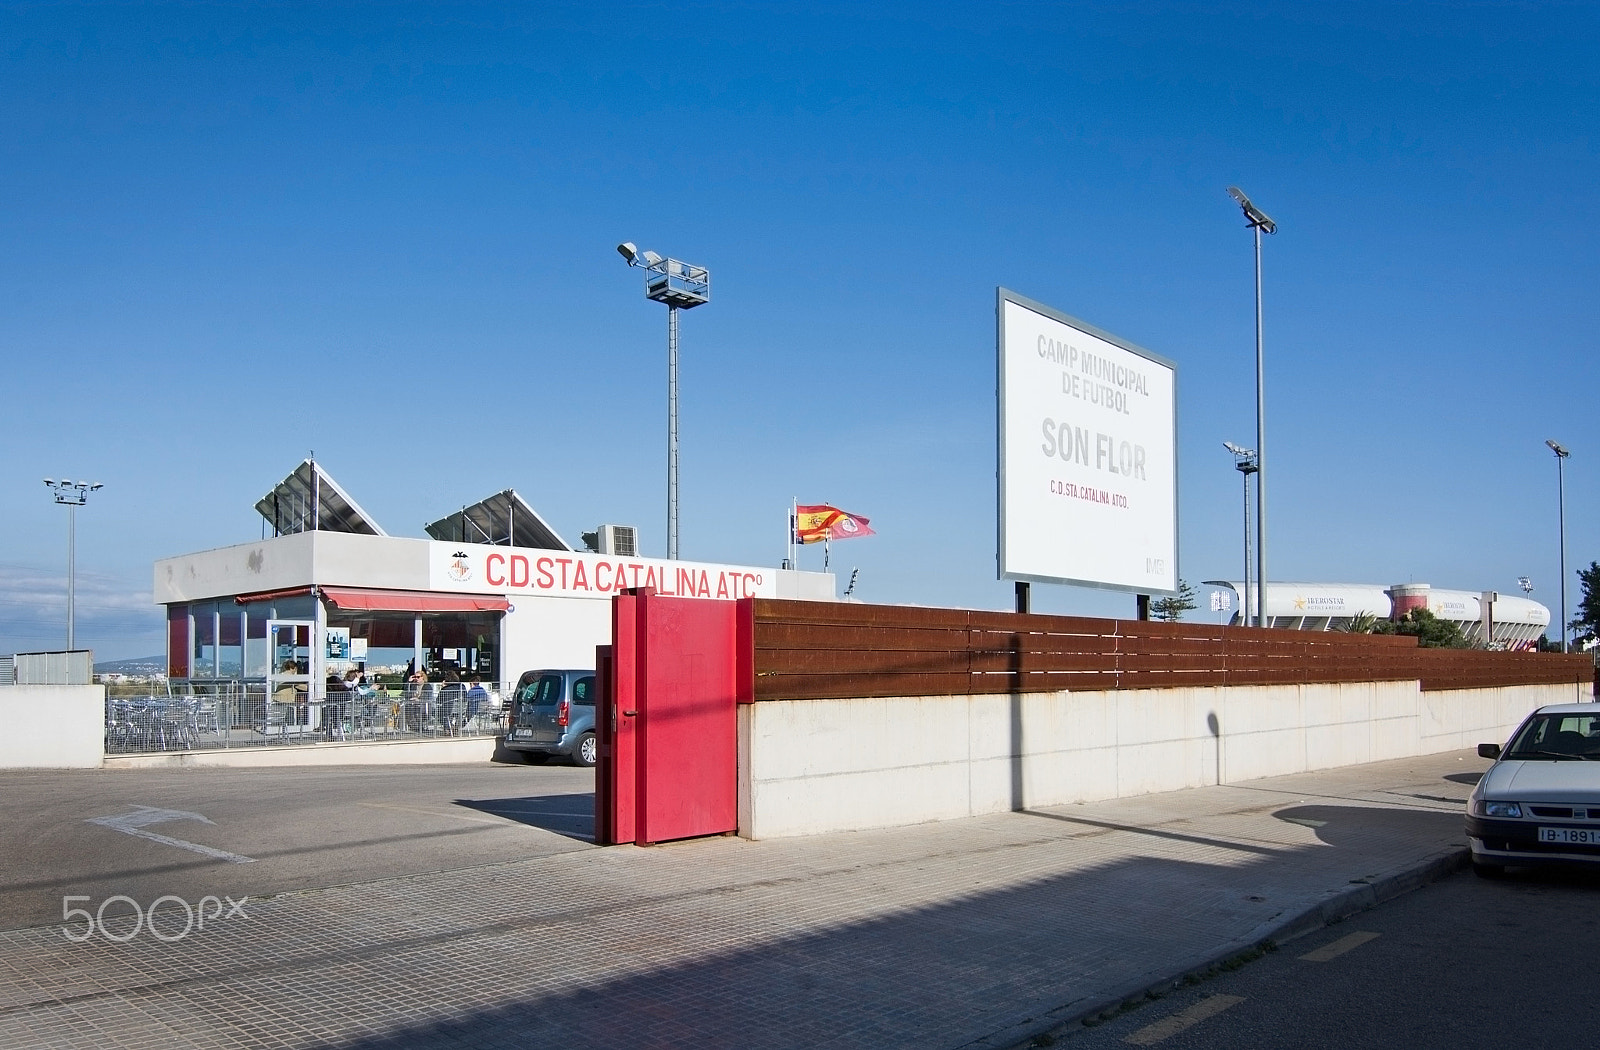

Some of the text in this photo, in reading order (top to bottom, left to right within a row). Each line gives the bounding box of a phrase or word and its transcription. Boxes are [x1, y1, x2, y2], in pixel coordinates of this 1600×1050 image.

[1037, 334, 1149, 396] CAMP MUNICIPAL
[1062, 371, 1130, 415] DE FUTBOL
[1042, 417, 1147, 481] SON FLOR
[1307, 597, 1345, 605] IBEROSTAR
